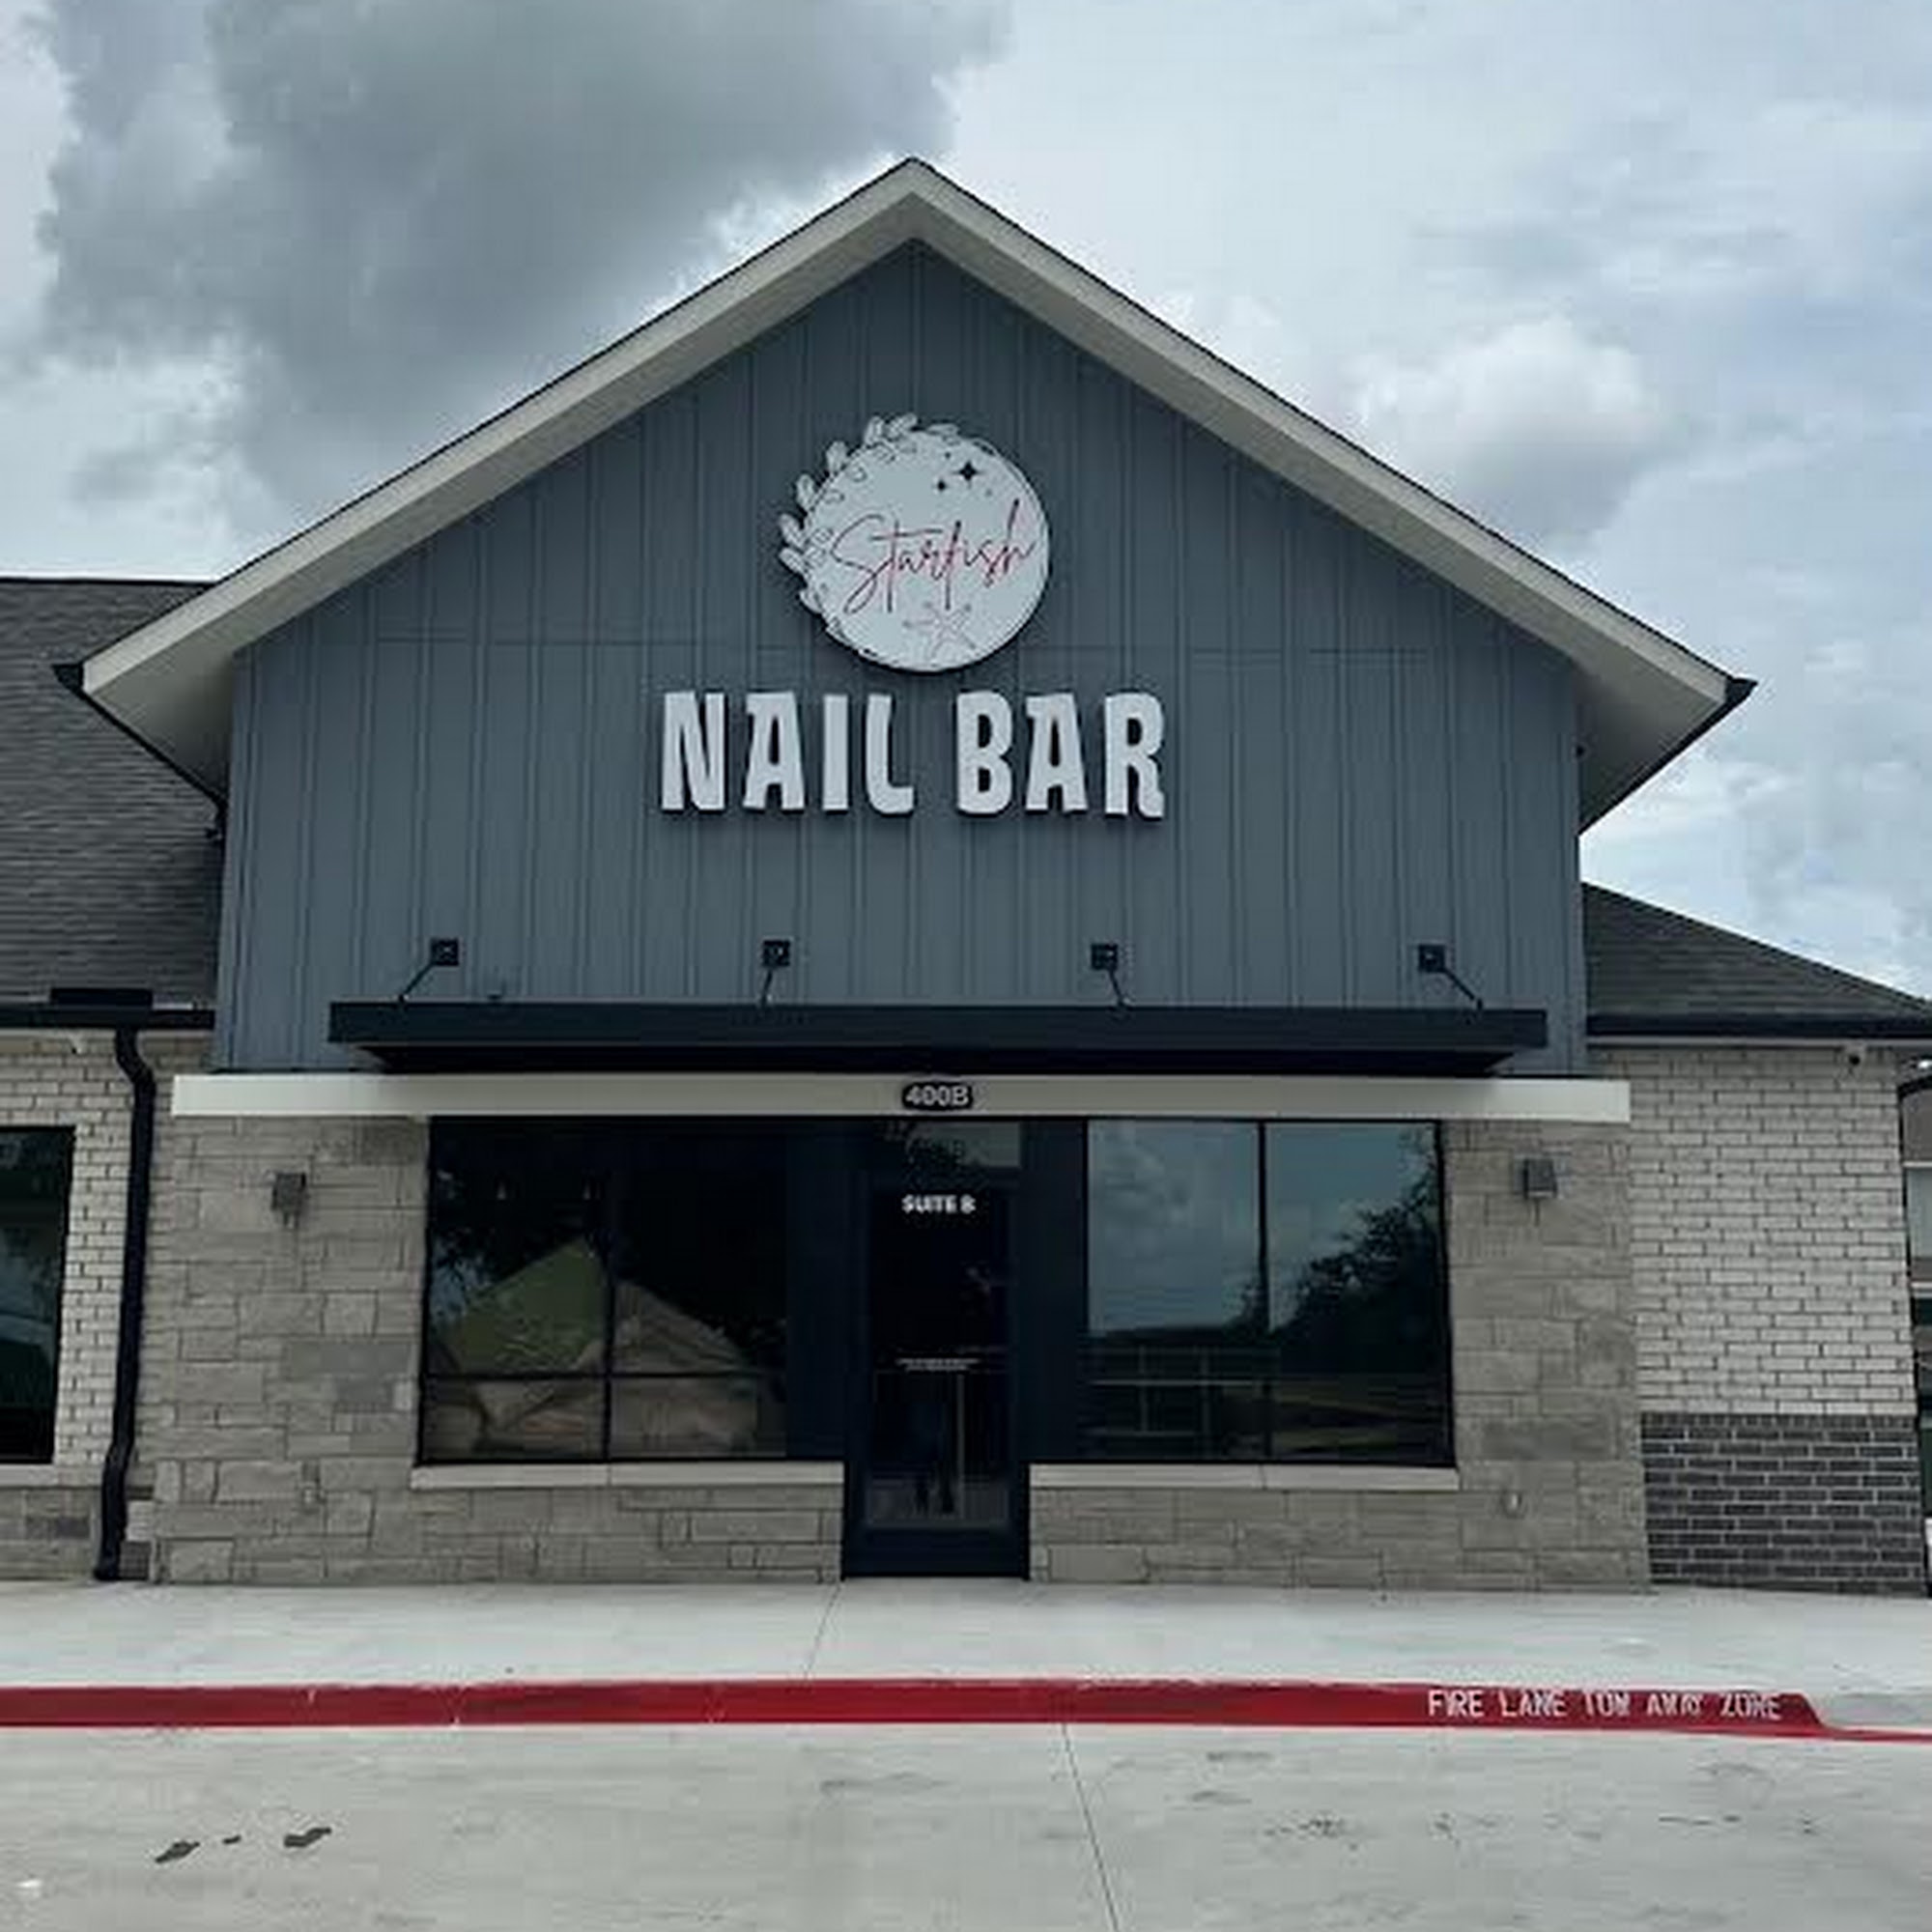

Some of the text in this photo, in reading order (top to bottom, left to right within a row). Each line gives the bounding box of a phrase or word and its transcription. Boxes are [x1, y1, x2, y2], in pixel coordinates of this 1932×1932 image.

[830, 497, 1037, 615] Starfish
[661, 690, 1166, 819] NAIL BAR
[905, 1085, 969, 1107] 400B
[900, 1194, 957, 1214] SUITE
[1428, 1689, 1783, 1719] FIRE LANE TOW AWAY ZONE
